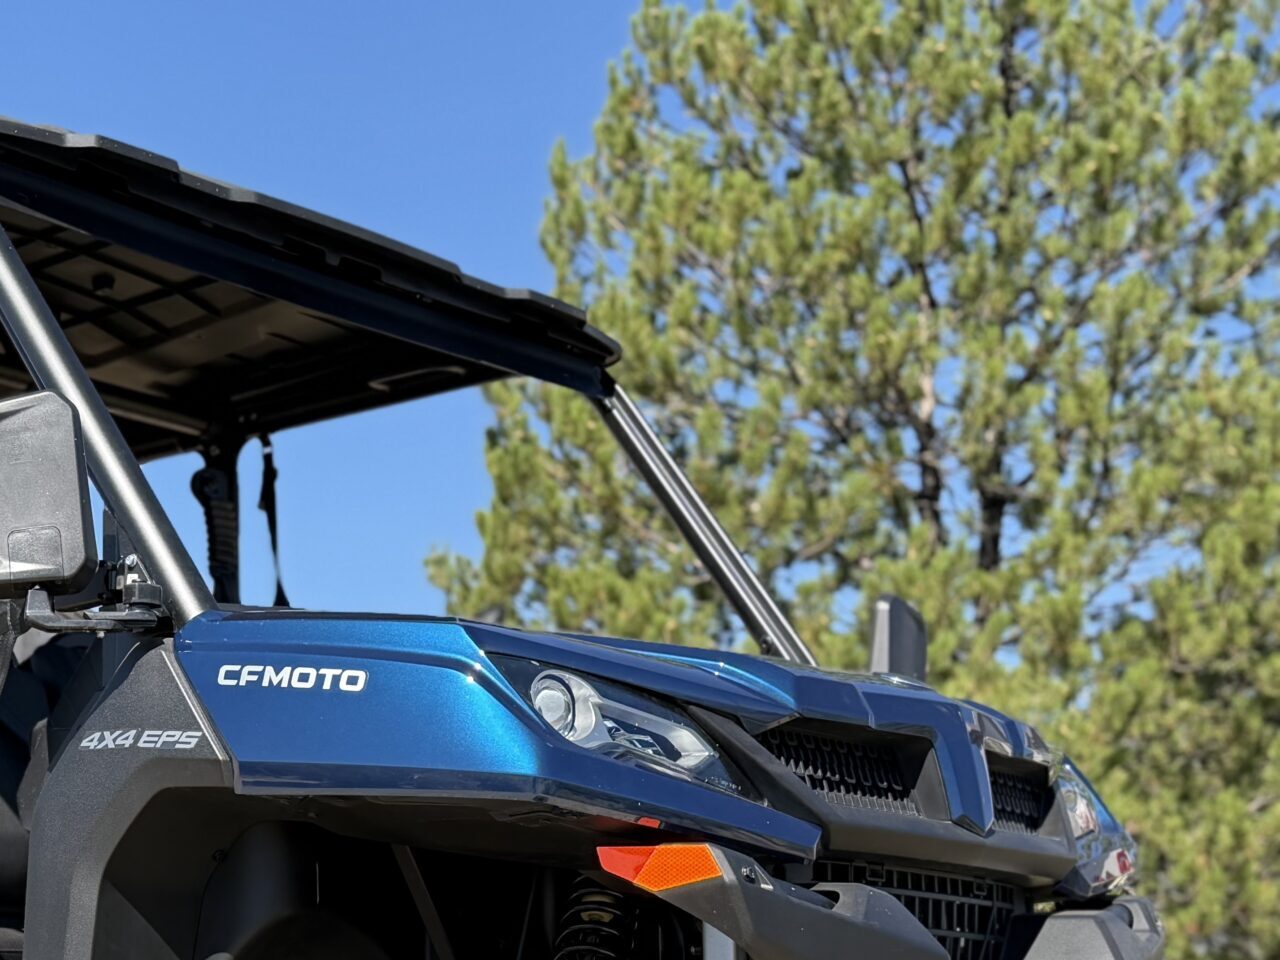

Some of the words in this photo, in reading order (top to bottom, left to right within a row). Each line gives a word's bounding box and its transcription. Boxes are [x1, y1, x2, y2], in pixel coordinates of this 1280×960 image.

[218, 664, 368, 692] CFMOTO
[79, 731, 136, 750] 4X4
[137, 730, 202, 749] EPS
